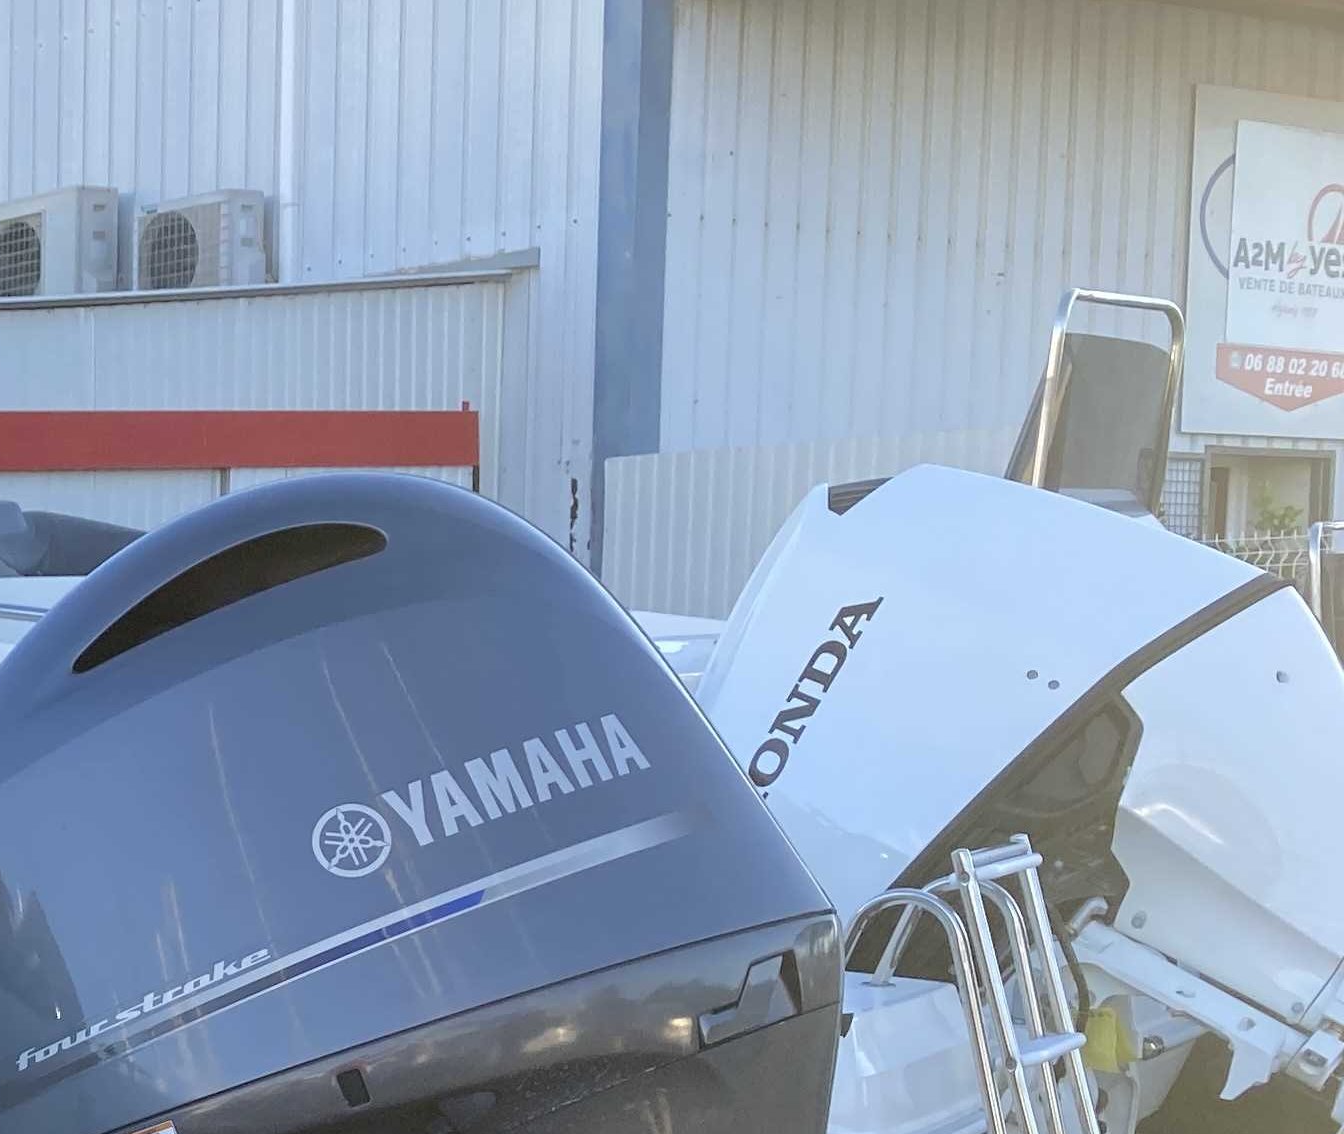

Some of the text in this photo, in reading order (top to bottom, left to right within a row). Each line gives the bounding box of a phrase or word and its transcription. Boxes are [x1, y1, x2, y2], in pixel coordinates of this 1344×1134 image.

[1233, 237, 1285, 272] A2M
[1308, 245, 1344, 279] ye
[1239, 276, 1344, 299] VENTE DE BATEAU
[1244, 353, 1264, 372] 06
[1288, 358, 1307, 376] 02
[1309, 360, 1329, 377] 20
[1264, 378, 1313, 399] Entrée
[748, 597, 884, 800] ONDA
[383, 714, 651, 847] YAMAHA
